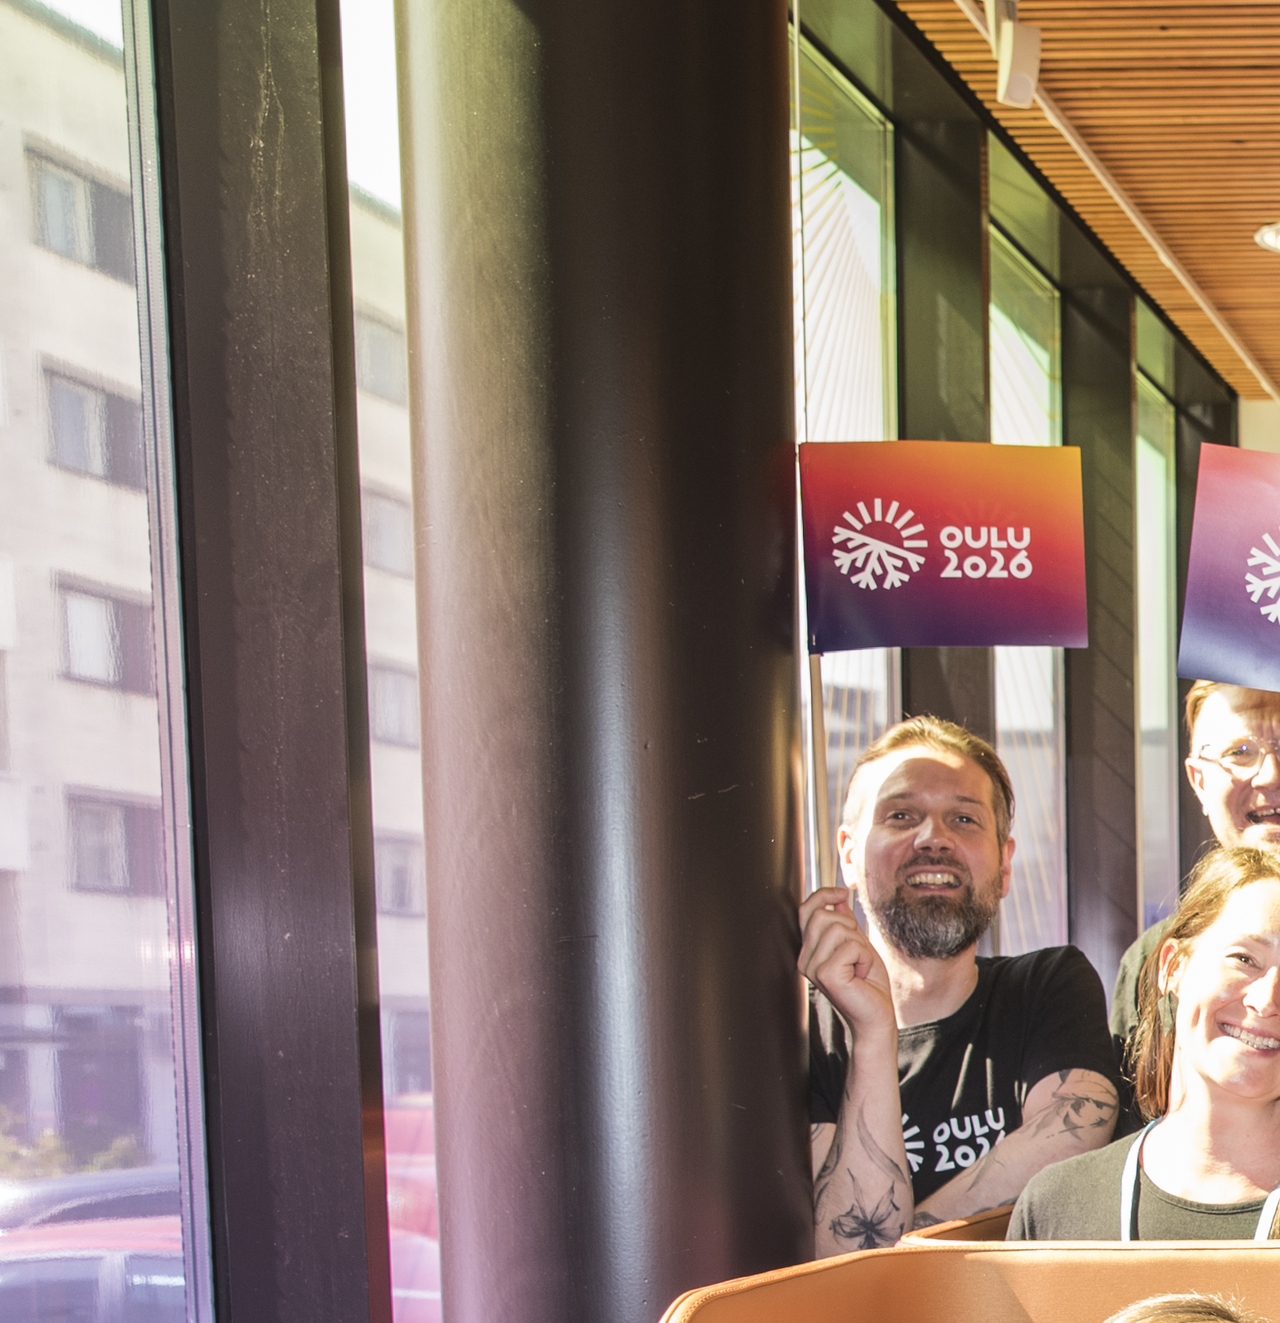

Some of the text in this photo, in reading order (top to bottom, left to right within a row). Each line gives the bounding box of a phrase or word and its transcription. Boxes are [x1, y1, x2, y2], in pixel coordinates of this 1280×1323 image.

[939, 525, 1031, 549] OULU
[940, 550, 1033, 579] 2026
[932, 1107, 1005, 1143] OULU
[934, 1130, 1006, 1172] 202
